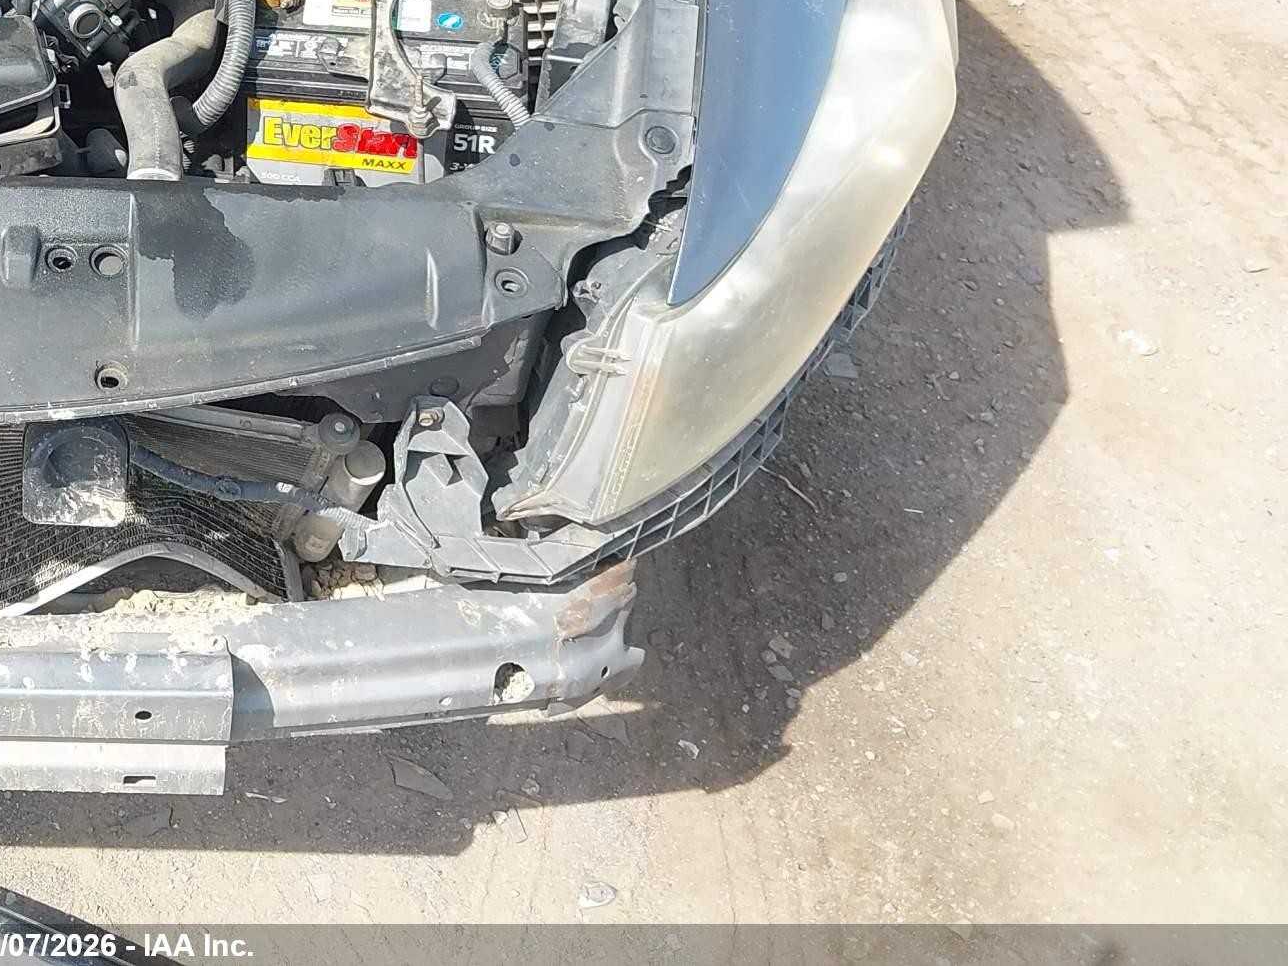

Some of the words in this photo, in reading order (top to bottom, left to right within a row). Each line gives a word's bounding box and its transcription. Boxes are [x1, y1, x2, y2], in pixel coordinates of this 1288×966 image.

[454, 123, 481, 132] GROUP
[481, 125, 499, 133] SIZE
[263, 115, 418, 160] EverStart
[453, 133, 496, 155] 51R
[362, 158, 406, 170] MAXX
